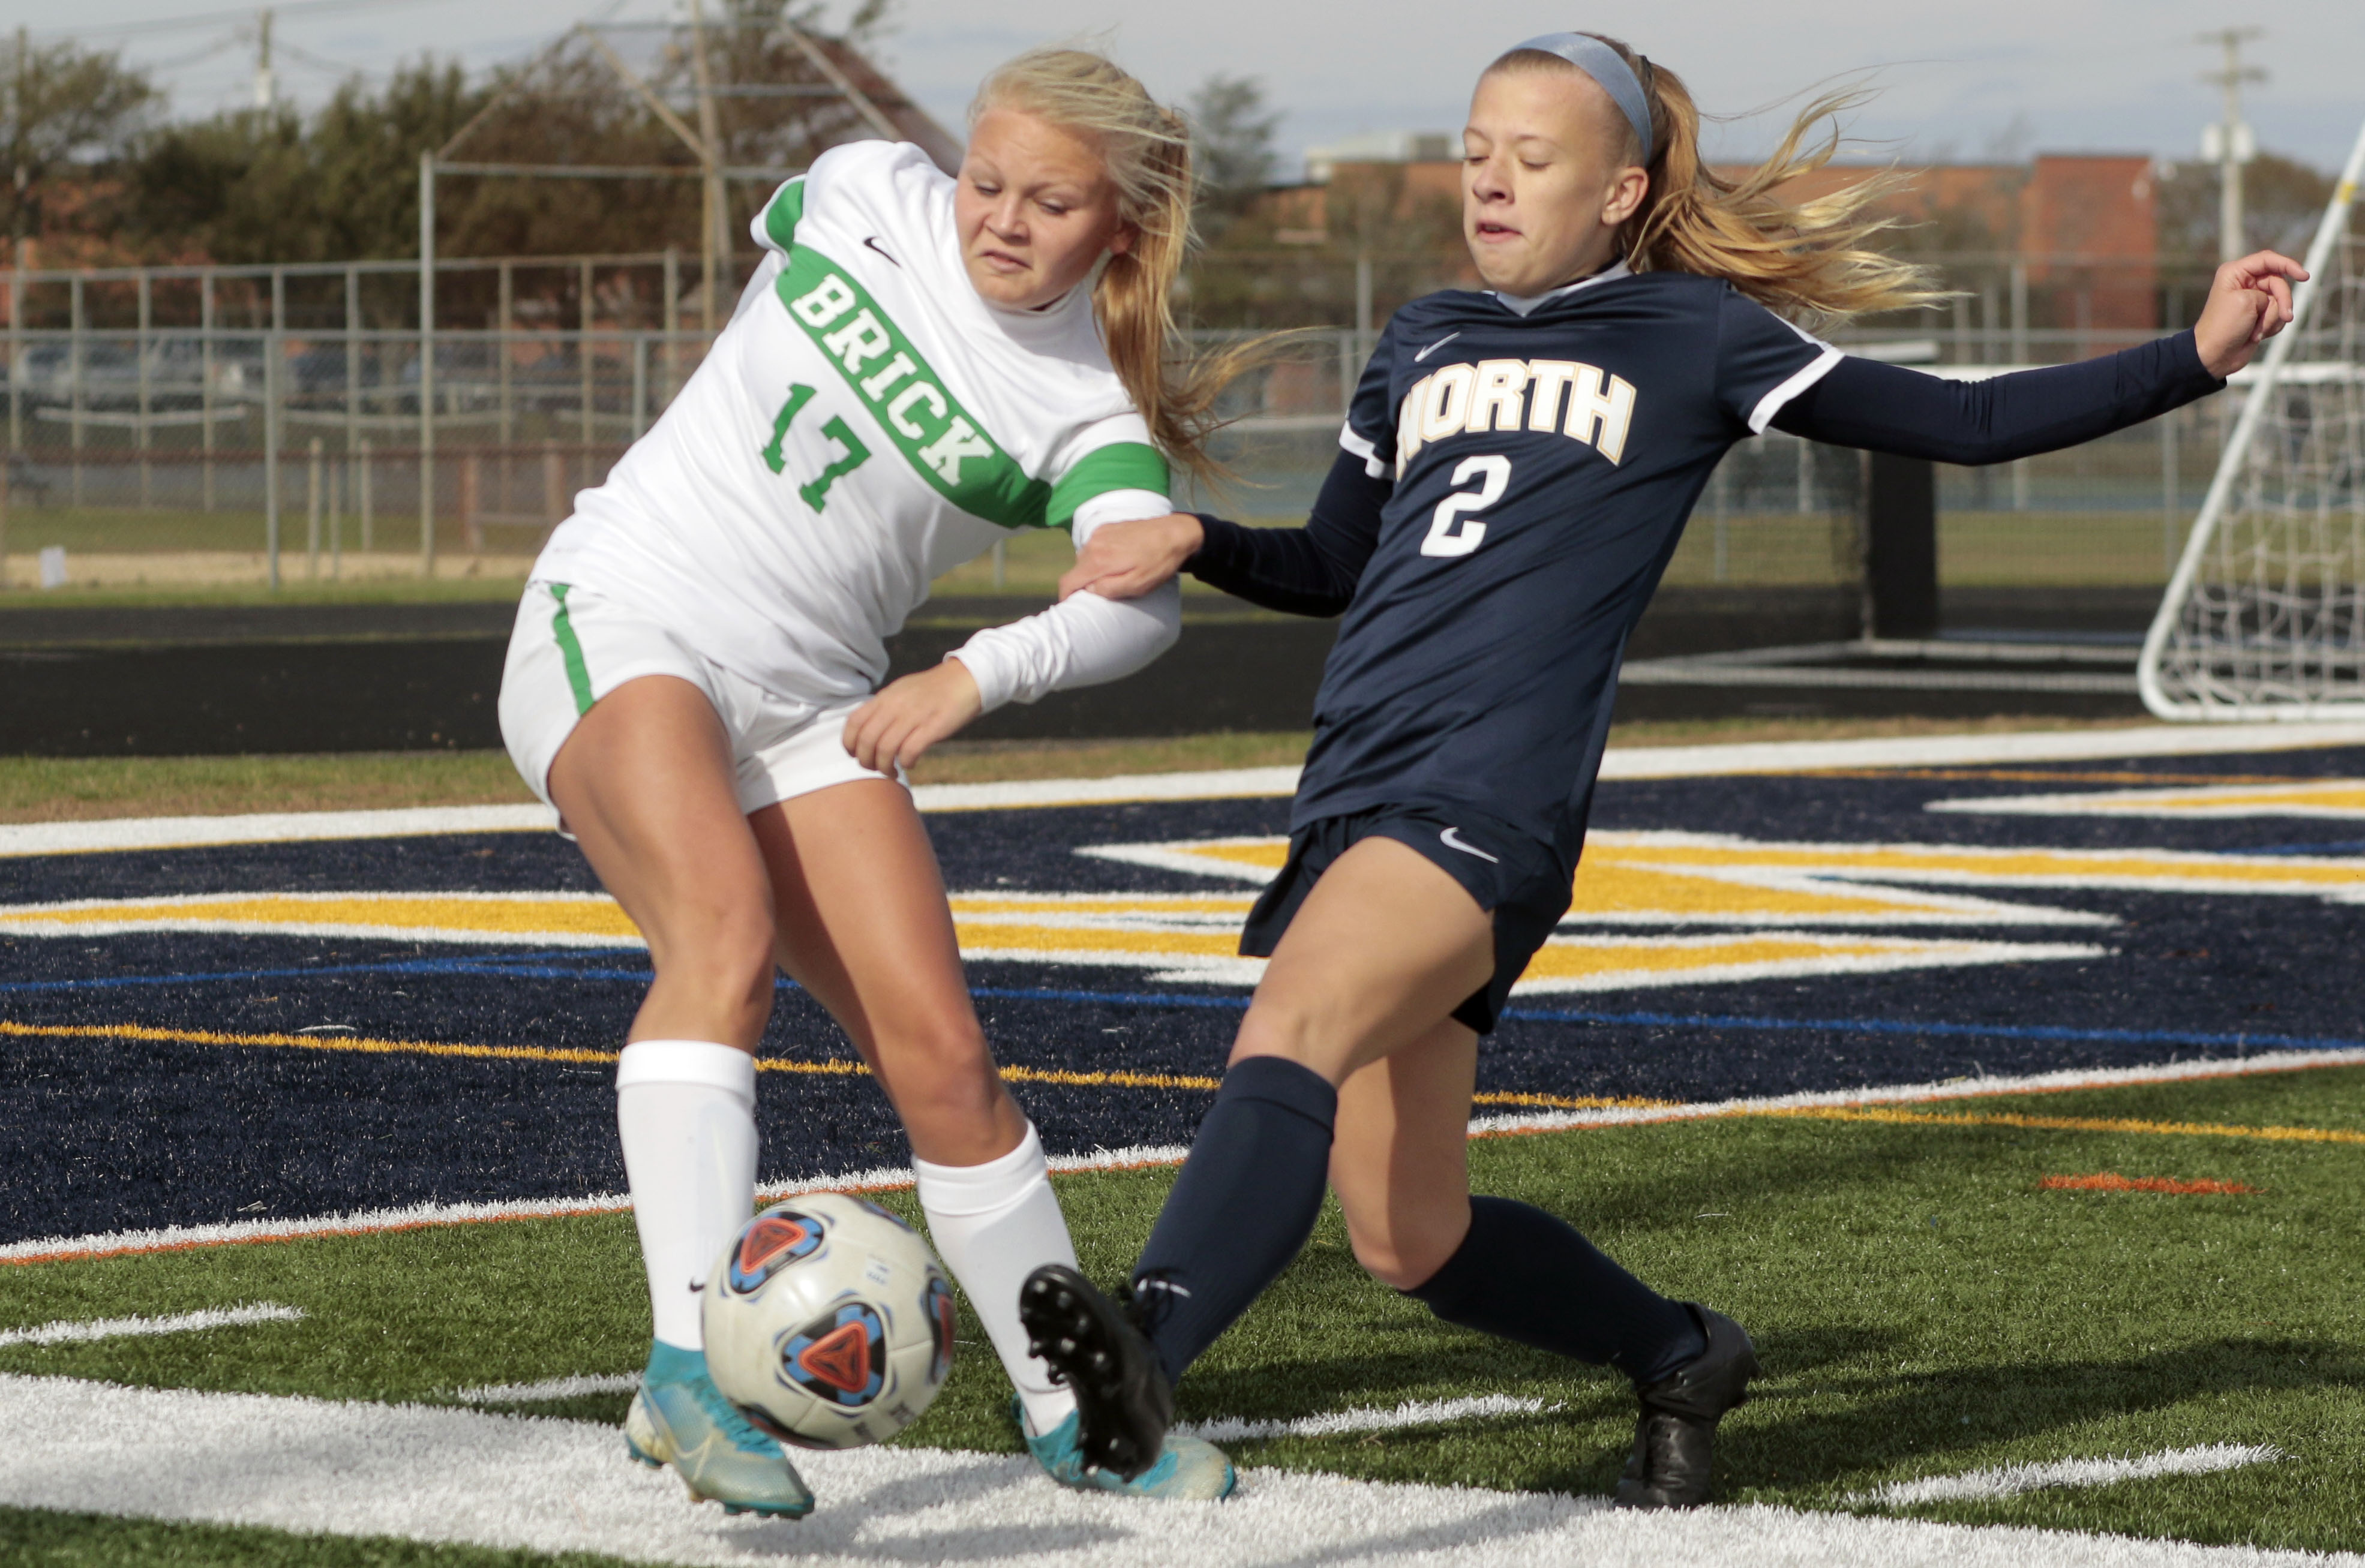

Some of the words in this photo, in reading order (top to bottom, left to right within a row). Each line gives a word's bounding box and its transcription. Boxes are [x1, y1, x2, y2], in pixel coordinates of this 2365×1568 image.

[790, 273, 995, 488] BRICK
[1396, 358, 1637, 482] NORTH
[761, 382, 872, 515] 17
[1420, 455, 1511, 557] 2
